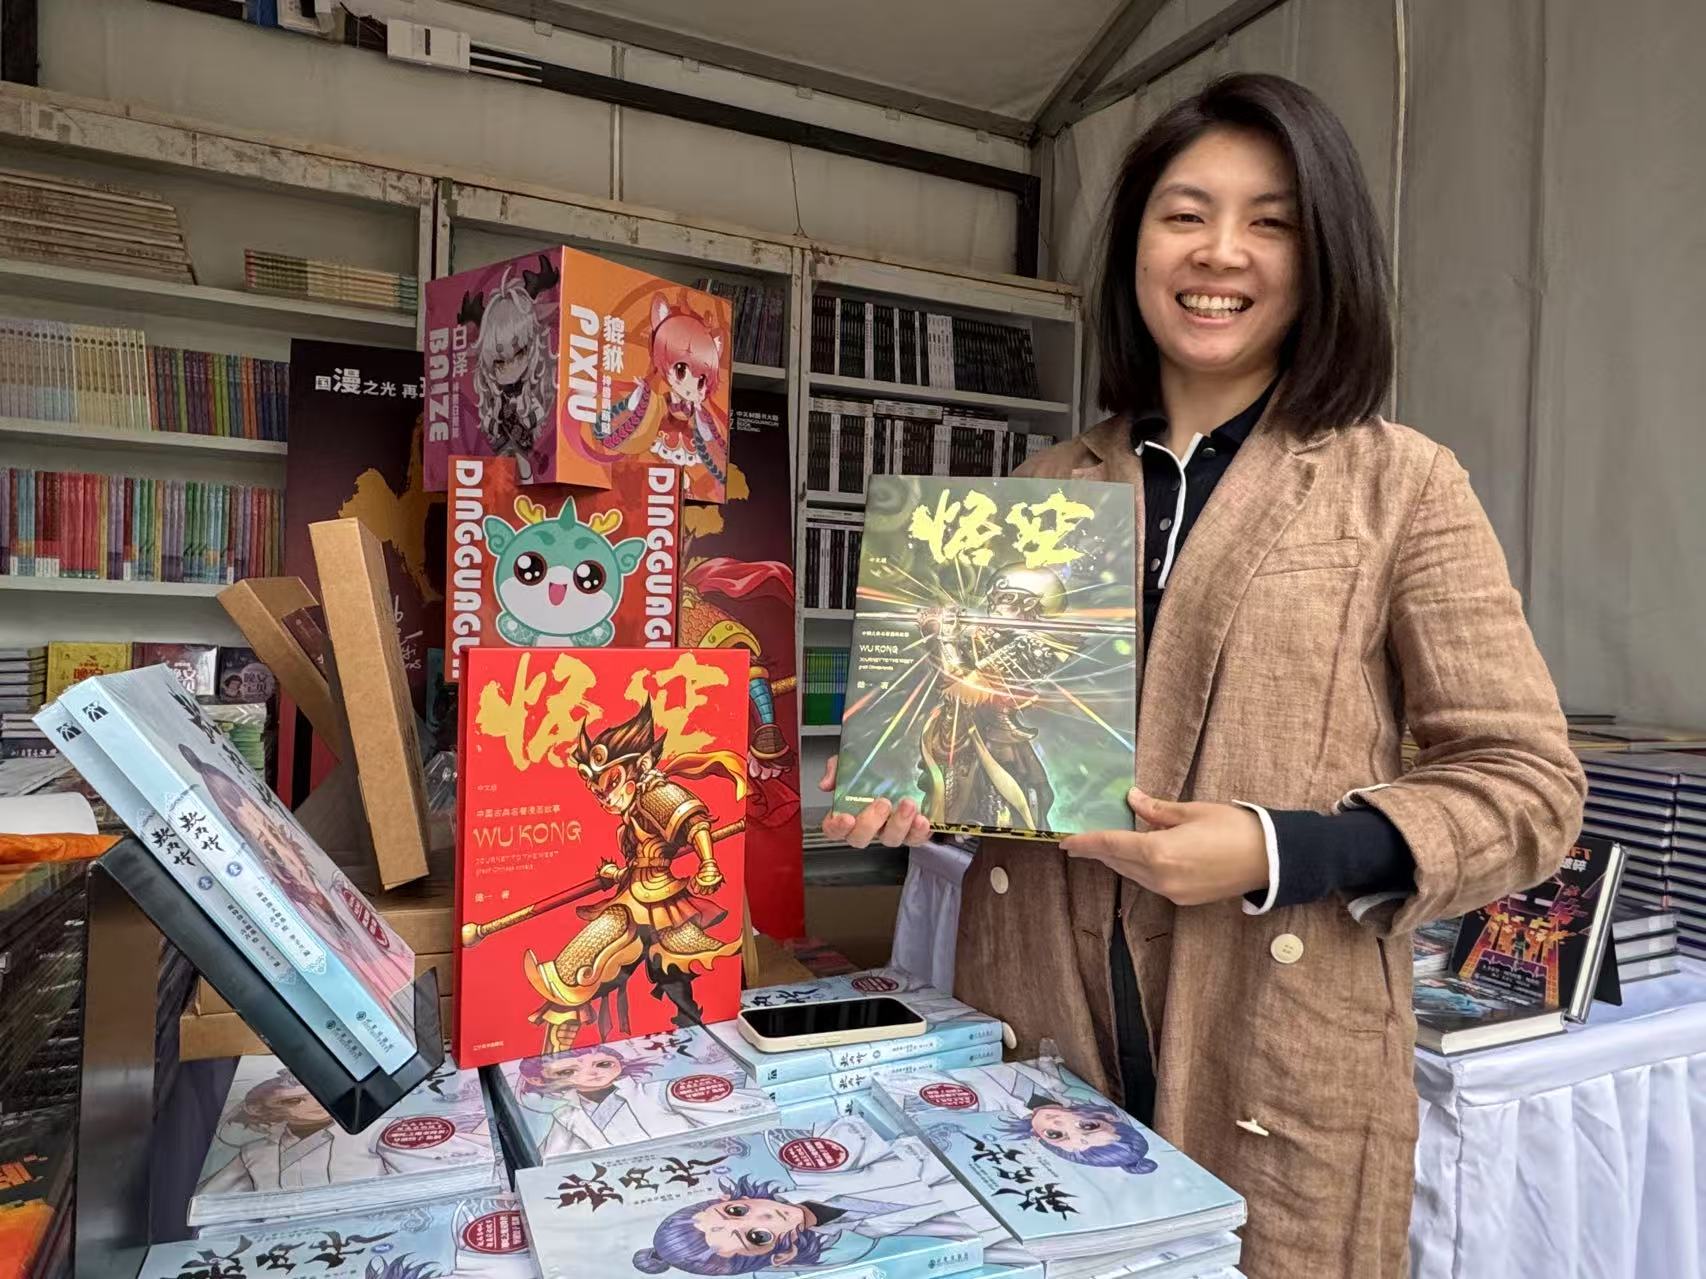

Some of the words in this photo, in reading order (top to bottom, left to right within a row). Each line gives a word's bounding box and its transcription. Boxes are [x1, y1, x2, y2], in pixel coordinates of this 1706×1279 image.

[315, 368, 396, 397] 国漫之光
[429, 328, 449, 441] BAIZE
[568, 304, 600, 423] PIXIU
[908, 489, 1095, 569] 悟空
[473, 826, 514, 847] WU
[519, 821, 582, 848] KONG
